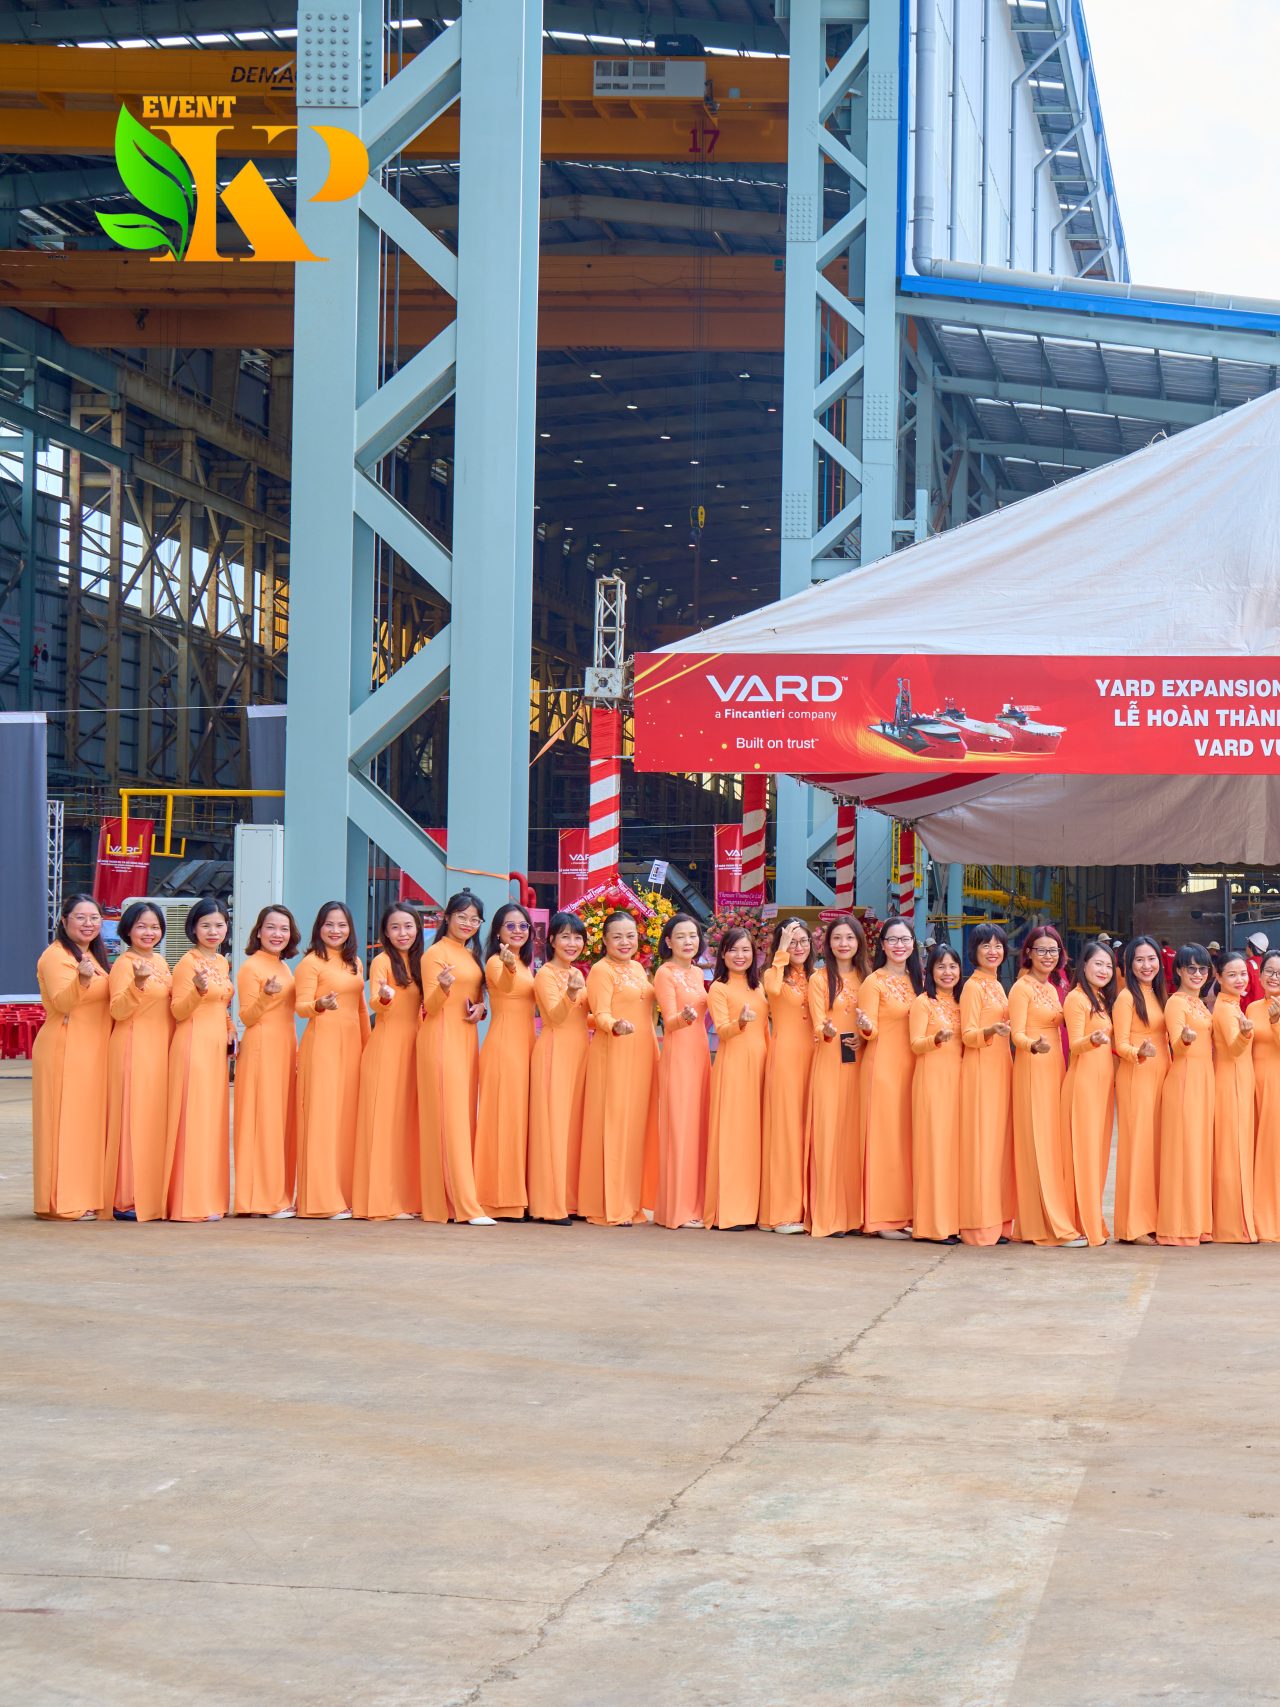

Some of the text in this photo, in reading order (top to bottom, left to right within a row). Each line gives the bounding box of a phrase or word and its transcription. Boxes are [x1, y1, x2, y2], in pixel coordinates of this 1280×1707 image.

[230, 66, 297, 83] DEMA
[688, 128, 720, 153] 17
[1095, 679, 1156, 697] YARD
[714, 708, 837, 721] a Fincantieri company
[1114, 700, 1141, 727] LỄ
[1147, 705, 1209, 727] HOÀN
[736, 737, 764, 749] Built
[767, 739, 783, 749] on
[1194, 739, 1254, 757] VARD
